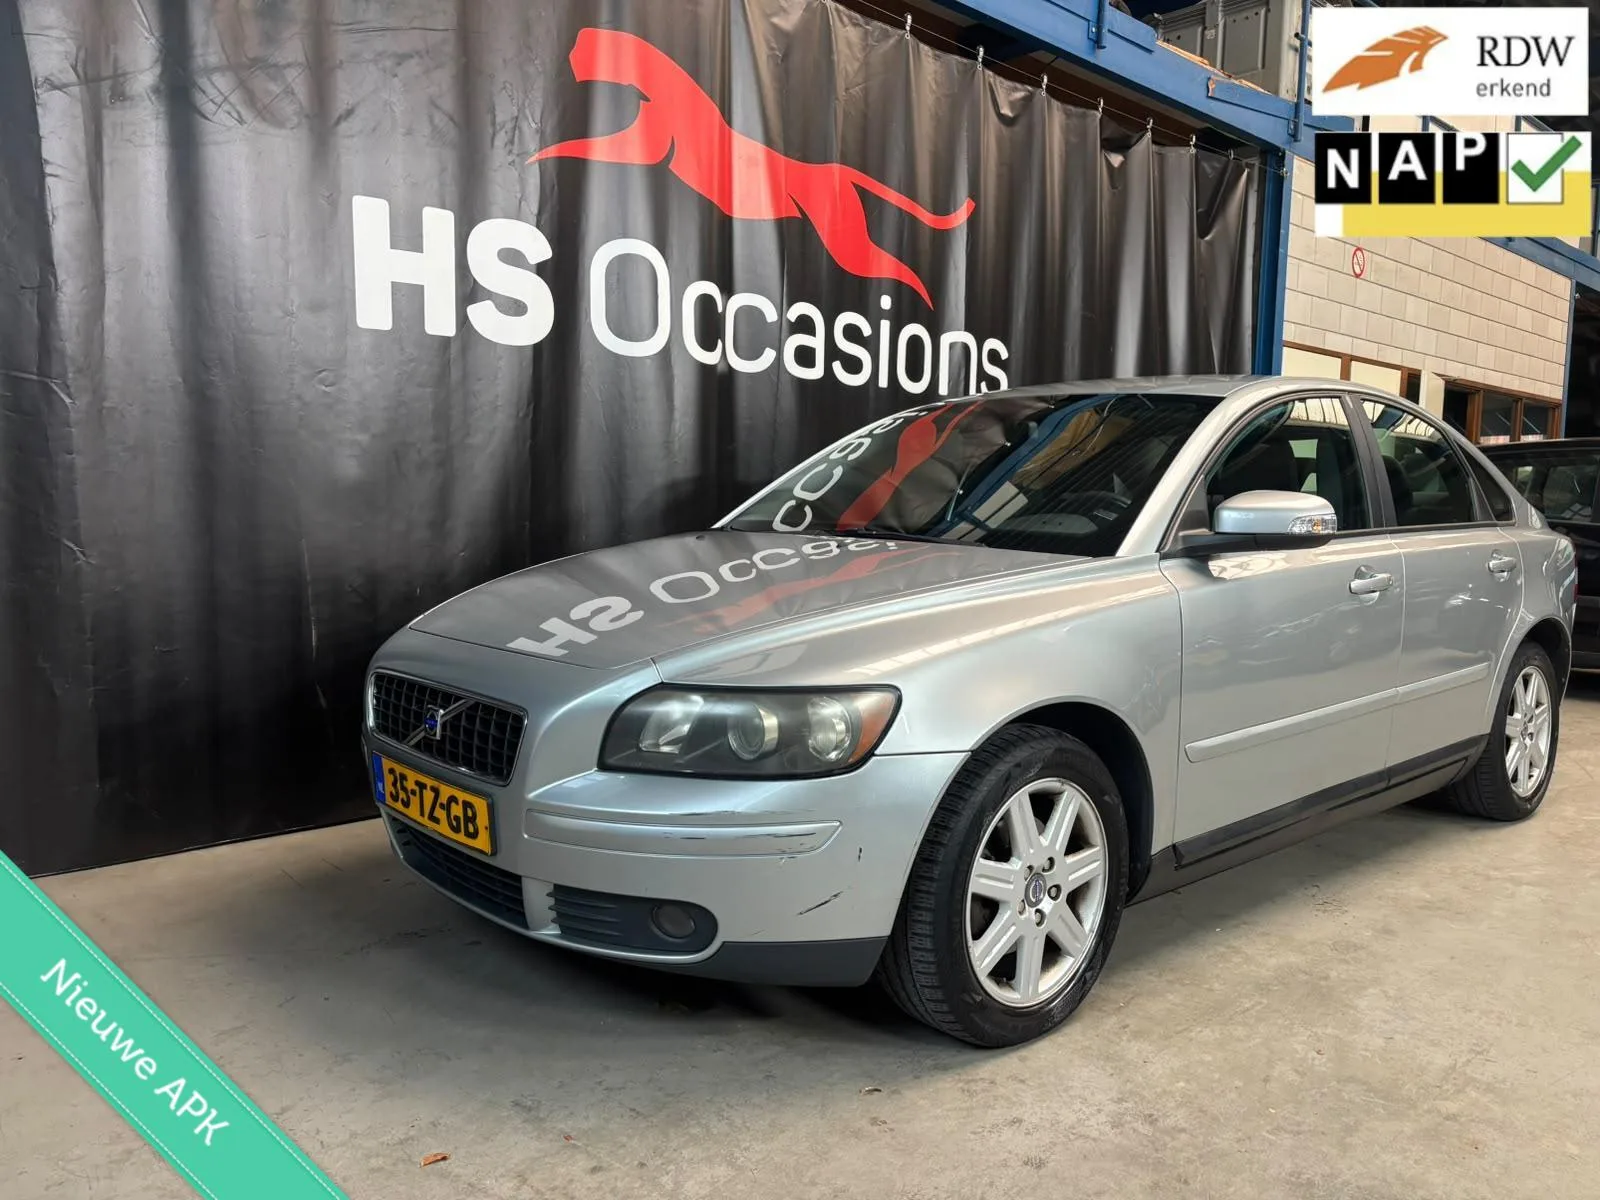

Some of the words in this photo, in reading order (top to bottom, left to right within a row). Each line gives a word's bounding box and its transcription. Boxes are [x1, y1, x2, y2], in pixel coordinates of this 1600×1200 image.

[352, 195, 554, 346] HS
[590, 238, 1009, 396] Occasions
[387, 767, 479, 841] 35-TZ-GB
